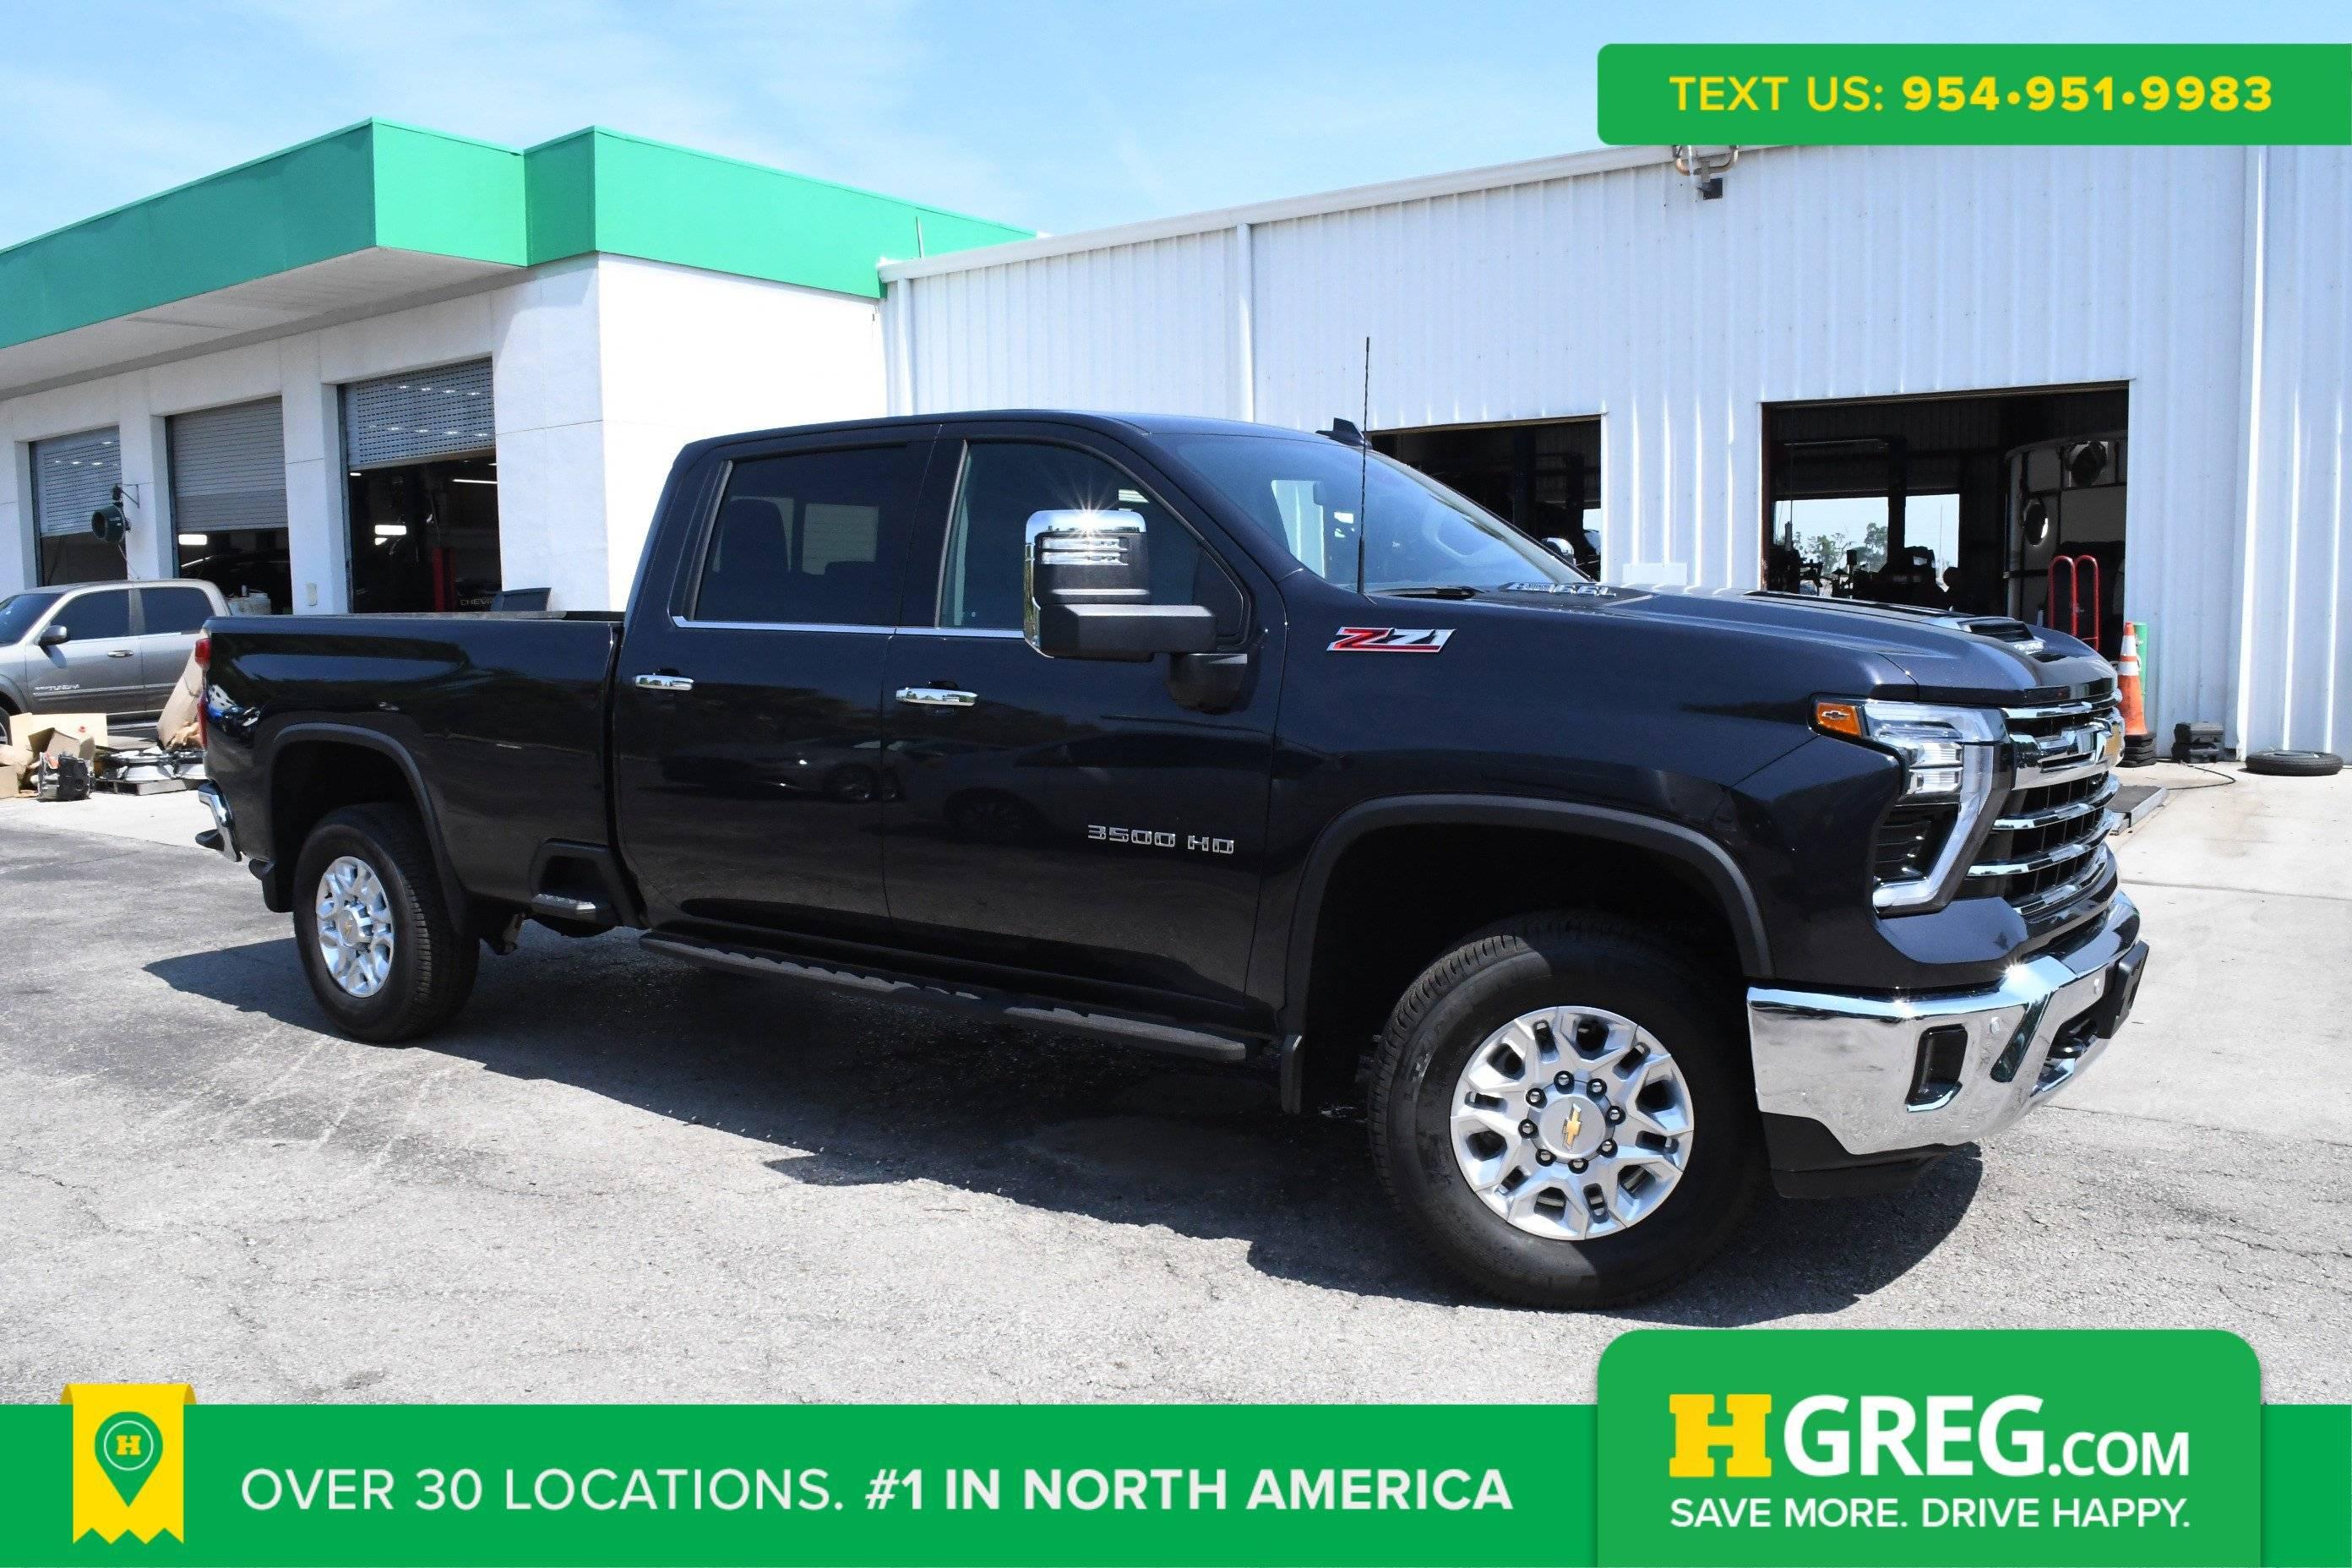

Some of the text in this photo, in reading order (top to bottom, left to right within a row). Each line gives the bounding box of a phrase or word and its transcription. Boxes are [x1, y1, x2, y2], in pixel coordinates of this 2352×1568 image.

[1326, 626, 1456, 653] Z71
[1087, 825, 1235, 855] 3500 HD
